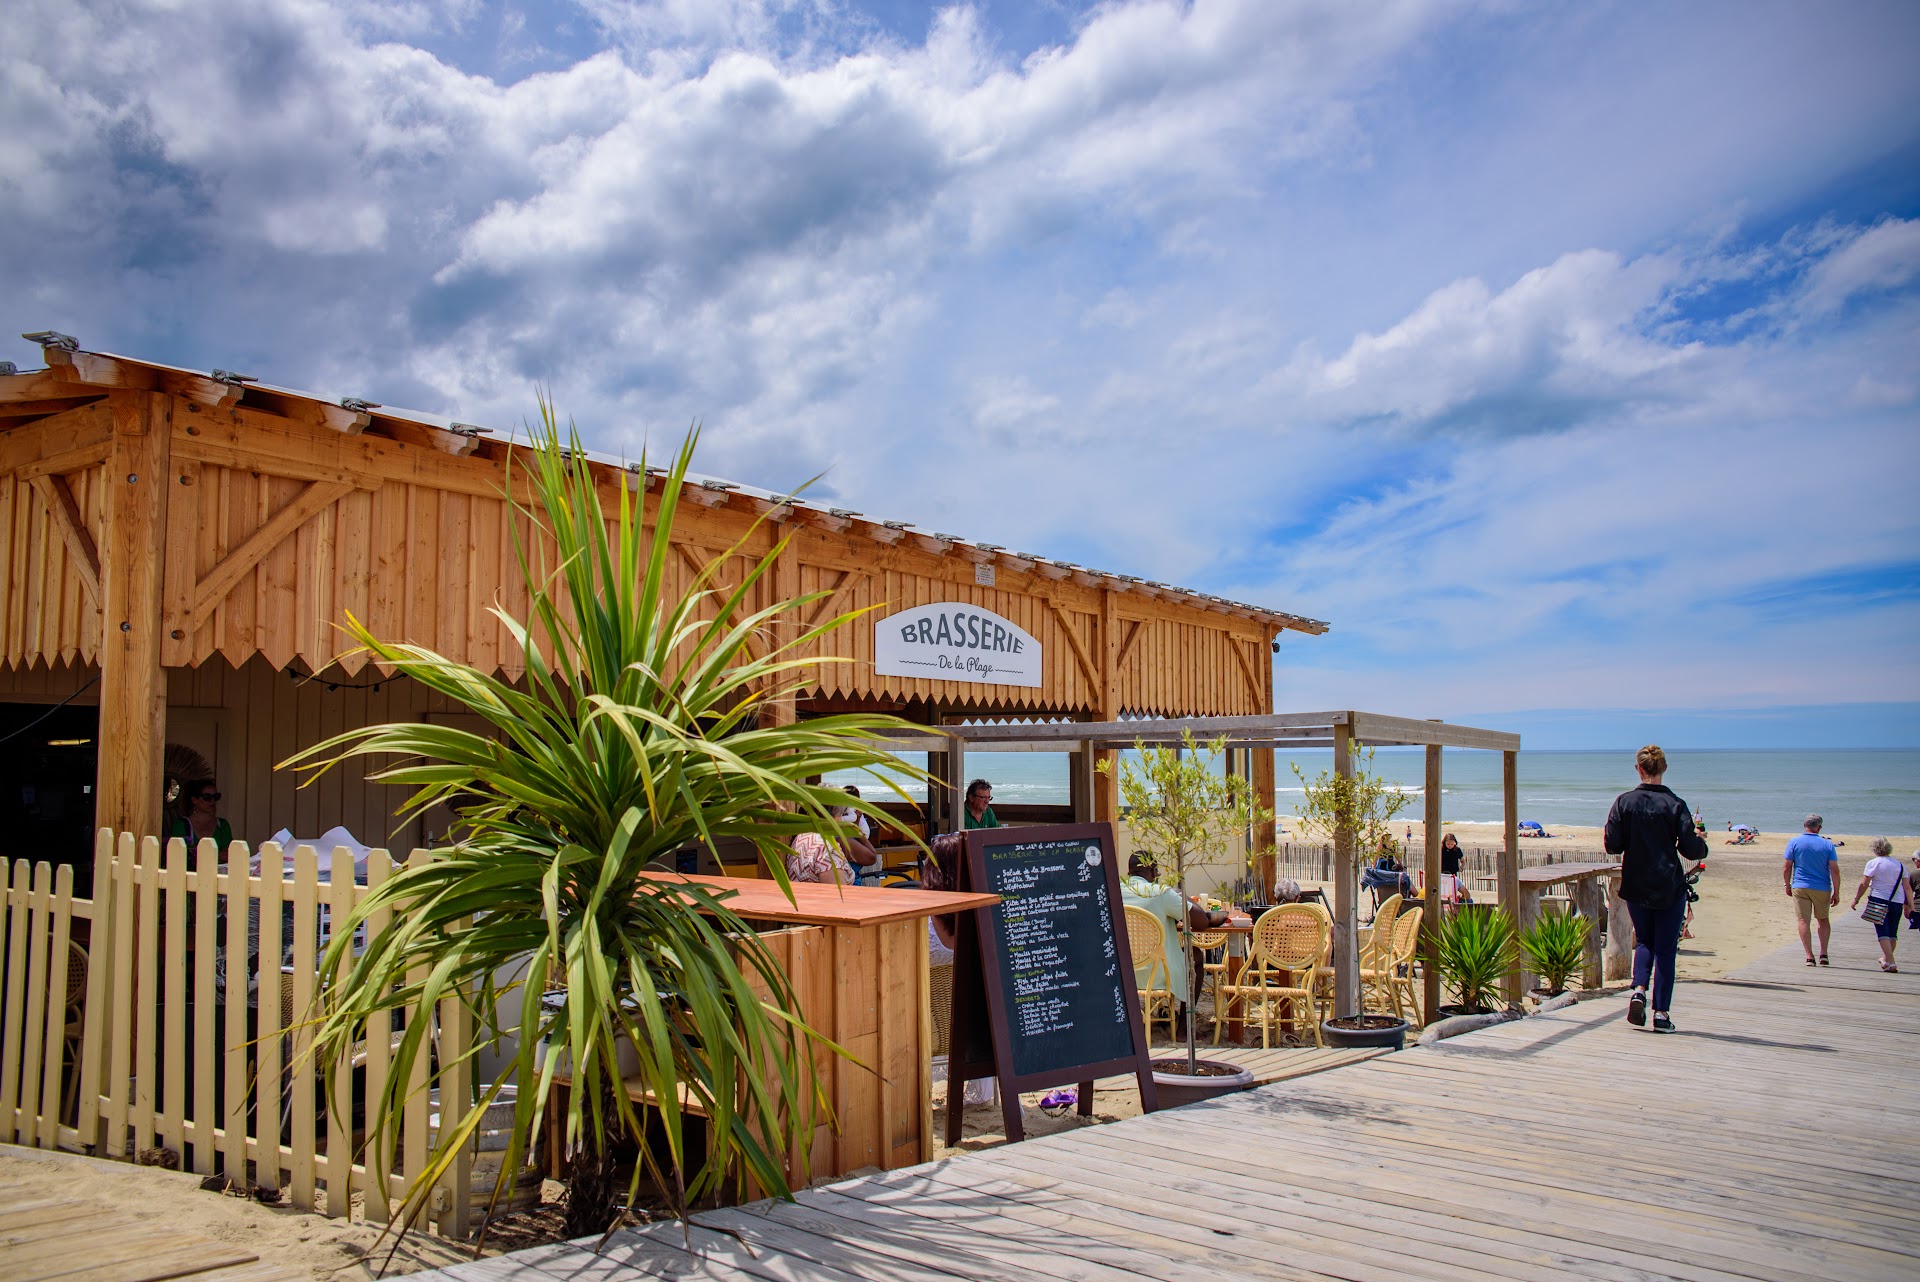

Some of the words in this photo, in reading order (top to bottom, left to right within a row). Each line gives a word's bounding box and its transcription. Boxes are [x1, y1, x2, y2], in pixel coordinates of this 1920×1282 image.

[901, 612, 1025, 654] BRASSERIE
[938, 655, 953, 669] De
[954, 655, 965, 670] la
[966, 657, 994, 678] Plage
[992, 851, 1034, 860] BRASSERIE
[1065, 846, 1086, 854] PLAGE
[1002, 868, 1022, 877] Salade
[1015, 957, 1031, 965] Moules
[1042, 955, 1067, 968] roquefort
